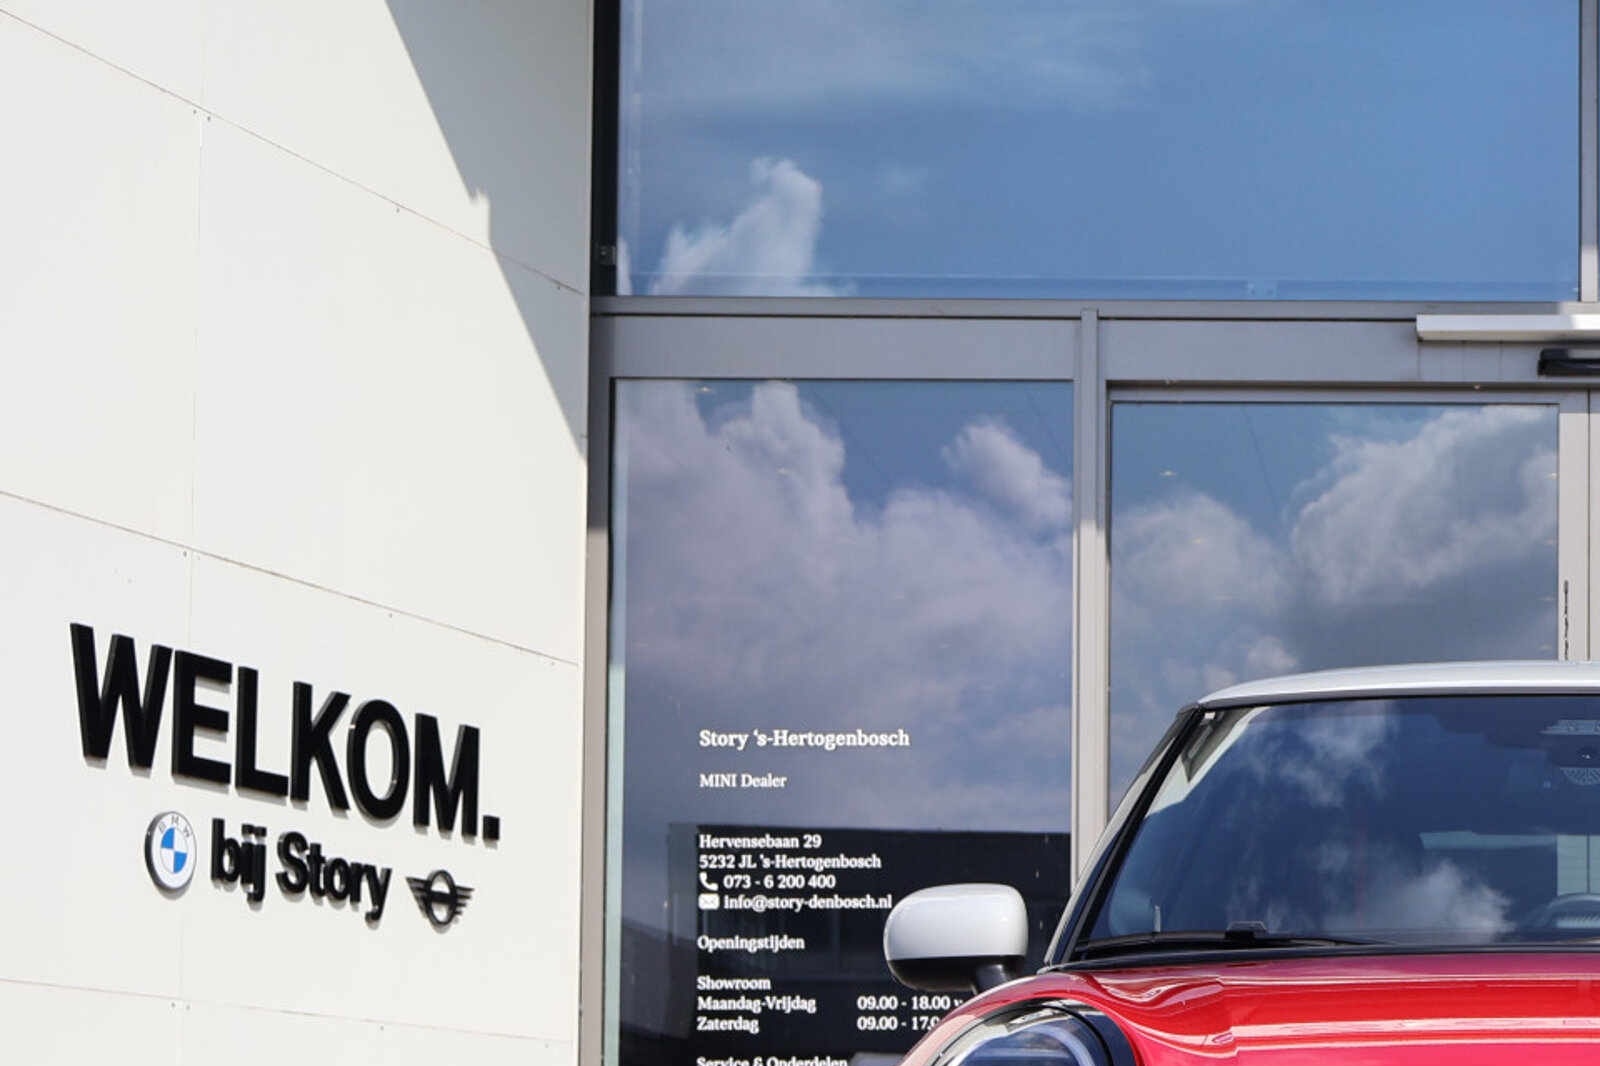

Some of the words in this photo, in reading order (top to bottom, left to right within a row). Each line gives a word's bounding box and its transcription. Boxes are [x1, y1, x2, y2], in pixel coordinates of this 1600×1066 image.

[69, 621, 500, 841] WELKOM.
[699, 729, 749, 751] Story
[699, 773, 737, 788] MINI
[740, 773, 787, 788] Dealer
[699, 834, 799, 849] Hervensebaan
[803, 834, 822, 849] 29
[211, 817, 267, 903] bij
[276, 831, 392, 922] Story
[699, 854, 735, 869] 5232
[738, 854, 757, 869] JL
[723, 875, 751, 889] 073
[763, 875, 774, 889] 6
[777, 875, 805, 889] 200
[808, 875, 836, 889] 400
[724, 894, 892, 912] info@story-denbosch.nl
[697, 935, 805, 952] Openingstijden
[697, 976, 771, 990] Showroom
[697, 995, 817, 1013] Maandag-Vrijdag
[857, 995, 898, 1010] 09.00
[911, 995, 951, 1010] 18.00
[697, 1016, 759, 1034] Zaterdag
[857, 1016, 898, 1031] 09.00
[911, 1016, 941, 1031] 17.0
